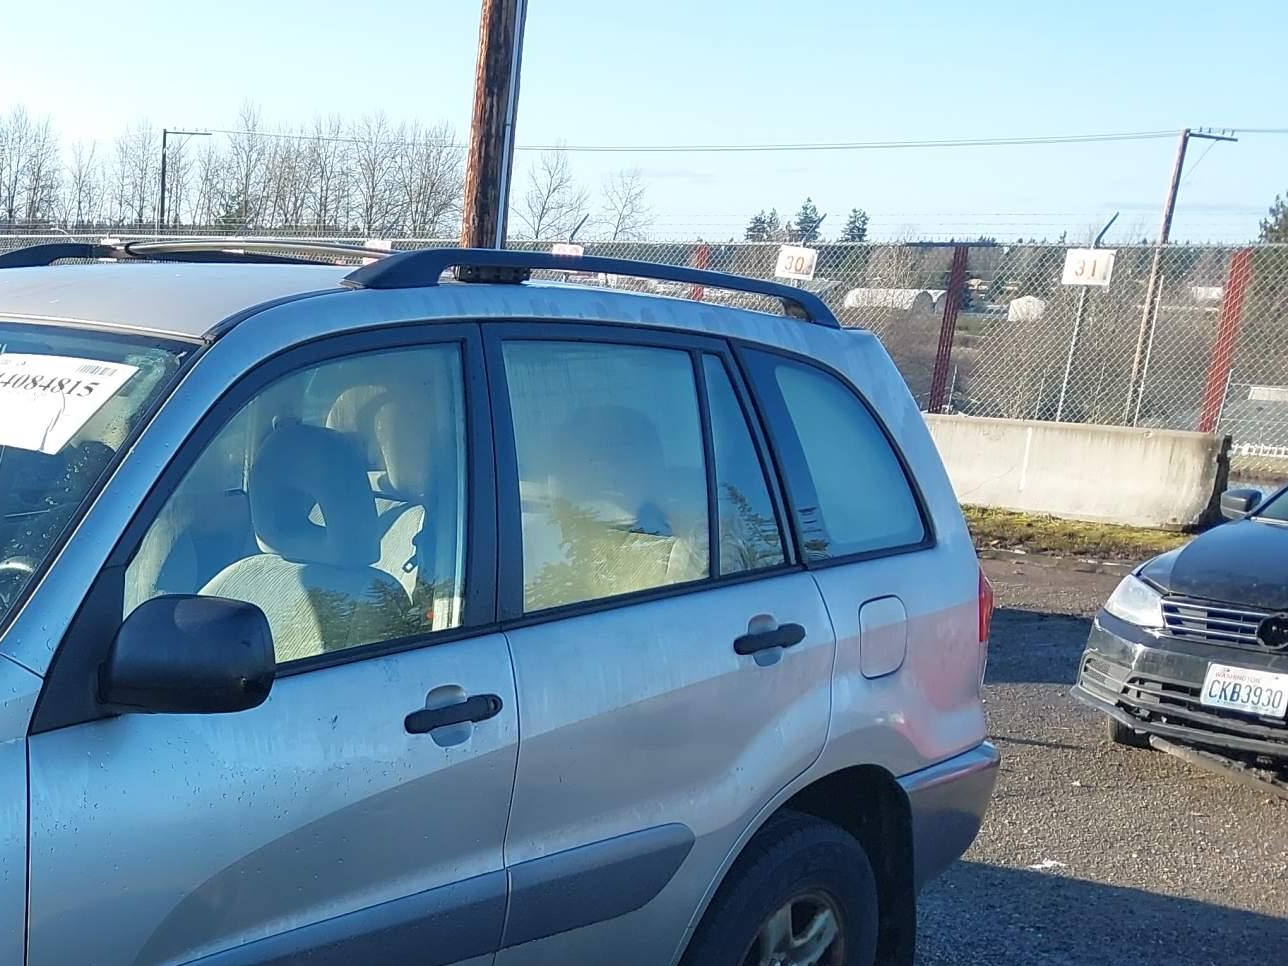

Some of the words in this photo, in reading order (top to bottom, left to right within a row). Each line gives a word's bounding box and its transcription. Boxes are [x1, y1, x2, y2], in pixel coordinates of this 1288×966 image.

[784, 255, 805, 272] 30
[1074, 259, 1097, 277] 31
[1215, 671, 1261, 684] WASHINGTON
[1208, 680, 1283, 709] CKB3930
